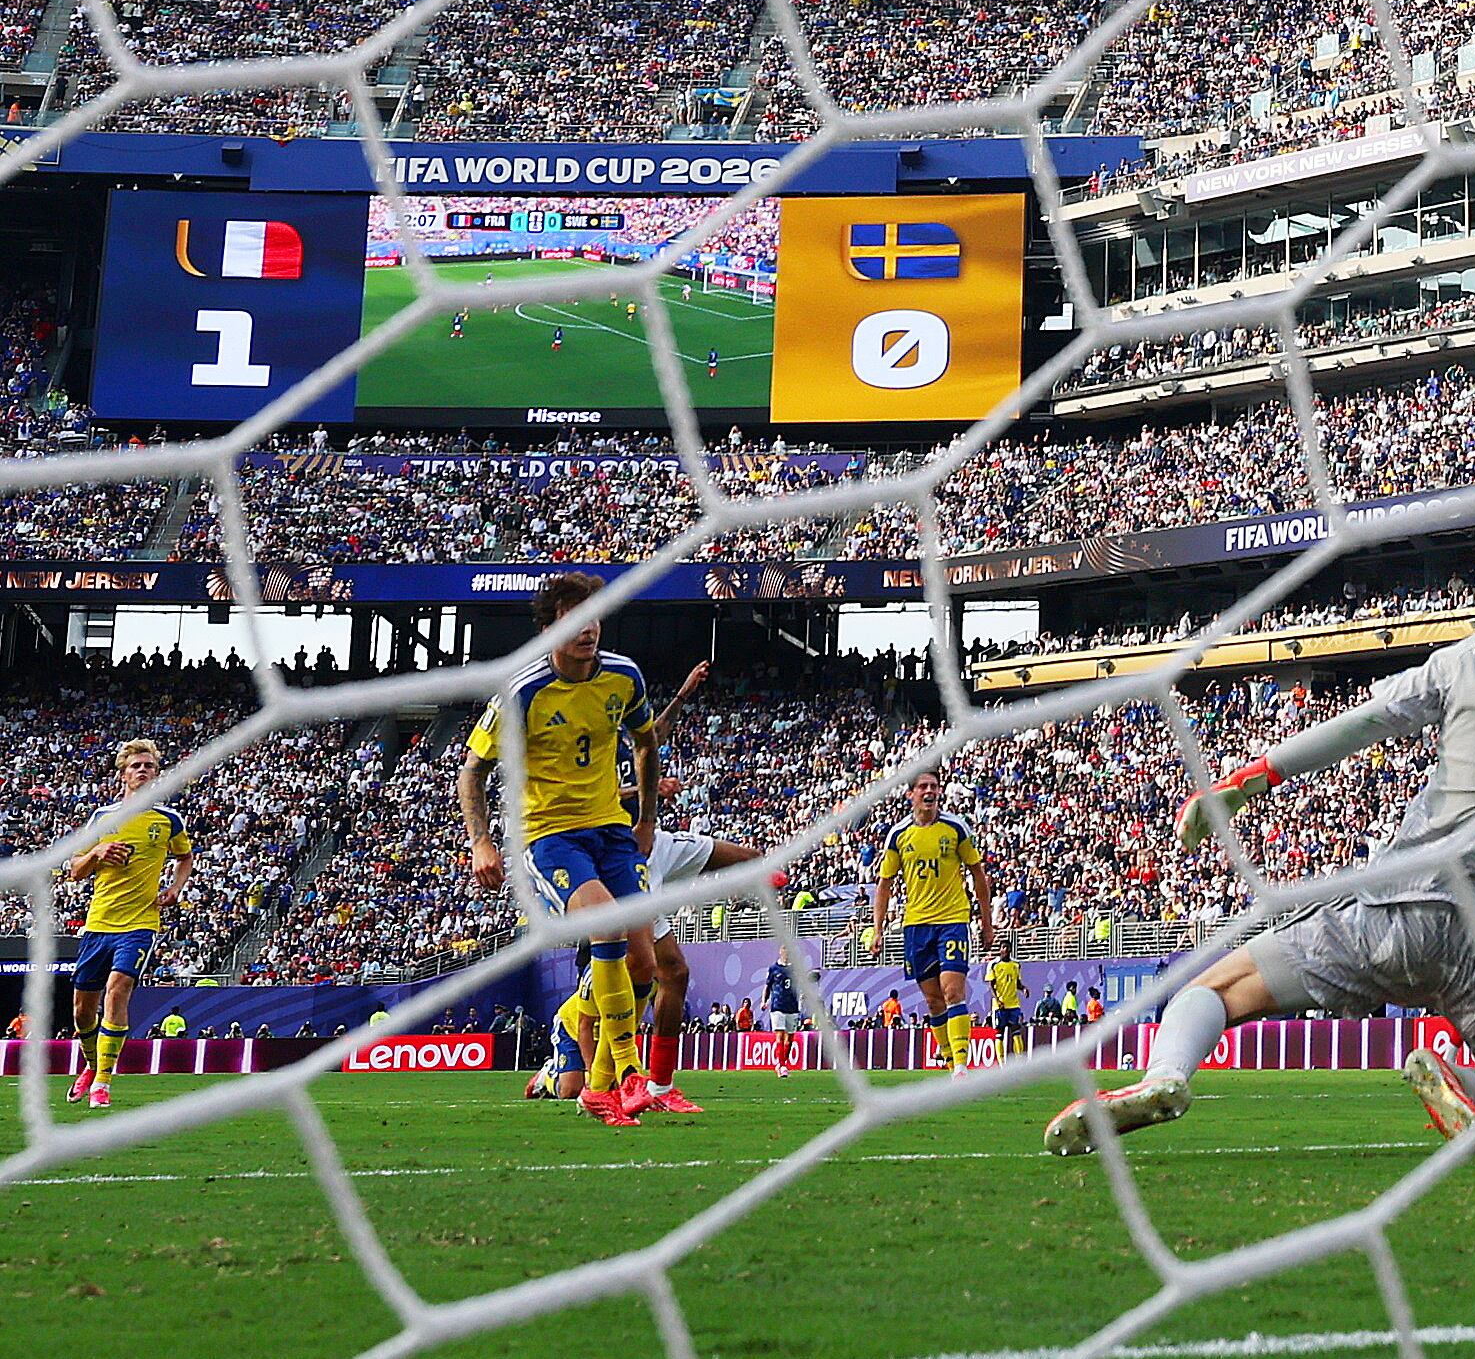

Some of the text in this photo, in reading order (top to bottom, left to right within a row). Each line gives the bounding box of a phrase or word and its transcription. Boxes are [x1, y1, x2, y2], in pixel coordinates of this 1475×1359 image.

[456, 157, 580, 184] WORLD
[585, 157, 655, 184] CUP
[660, 158, 780, 184] 2026
[1196, 170, 1239, 194] NEW
[1244, 160, 1296, 184] YORK
[1300, 149, 1344, 173] NEW
[396, 214, 437, 228] 2:07
[485, 214, 506, 227] FRA
[565, 214, 588, 228] SWE
[190, 310, 271, 387] 1
[527, 408, 602, 424] Hisense
[1225, 525, 1269, 551] FIFA
[1022, 550, 1083, 576] JERSEY
[6, 571, 159, 590] NEW JERSEY
[576, 735, 591, 767] 3
[635, 864, 649, 892] 3
[917, 858, 940, 879] 24
[945, 940, 967, 961] 24
[832, 991, 868, 1017] FIFA
[349, 1041, 486, 1069] Lenovo
